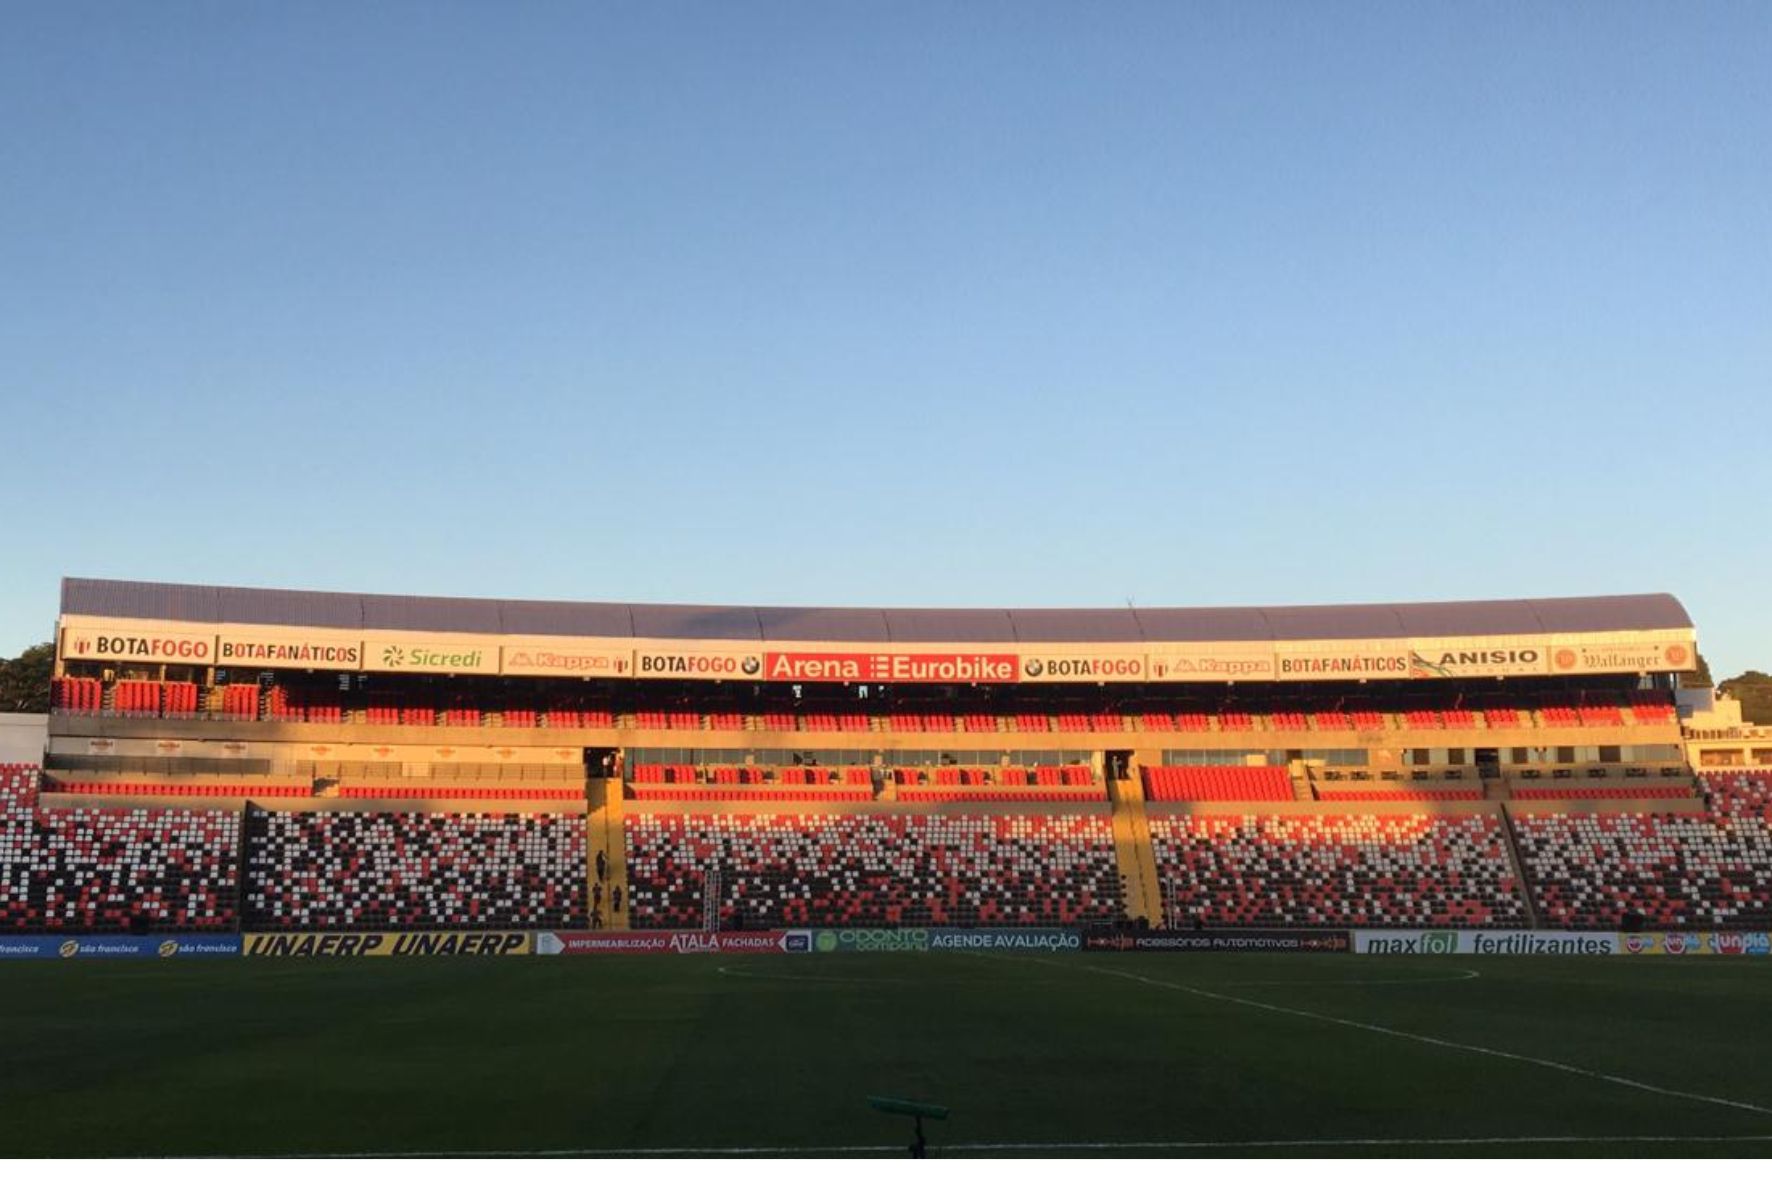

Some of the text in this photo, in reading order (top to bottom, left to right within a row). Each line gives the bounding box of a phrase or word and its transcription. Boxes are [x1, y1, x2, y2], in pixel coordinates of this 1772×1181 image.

[96, 636, 209, 659] BOTAFOGO
[222, 642, 358, 663] BOTAFANÁTICOS
[409, 648, 482, 668] Sicredi
[536, 653, 610, 669] Kappa
[641, 655, 737, 674] BOTAFOGO
[772, 654, 1013, 680] Arena Eurobike
[1047, 659, 1140, 677] BOTAFOGO
[1199, 658, 1271, 675] Kappa
[1281, 655, 1407, 673] BOTAFANÁTICOS
[1439, 650, 1539, 666] ANISIO
[252, 934, 383, 957] UNAERP
[392, 934, 525, 956] UNAERP
[568, 937, 666, 950] IMPERMEABILIZAÇÃO
[669, 932, 720, 954] ATALA
[722, 937, 775, 948] FACHADAS
[932, 934, 992, 949] AGENDE
[994, 932, 1080, 951] AVALIAÇÃO
[1472, 933, 1613, 955] fertilizantes
